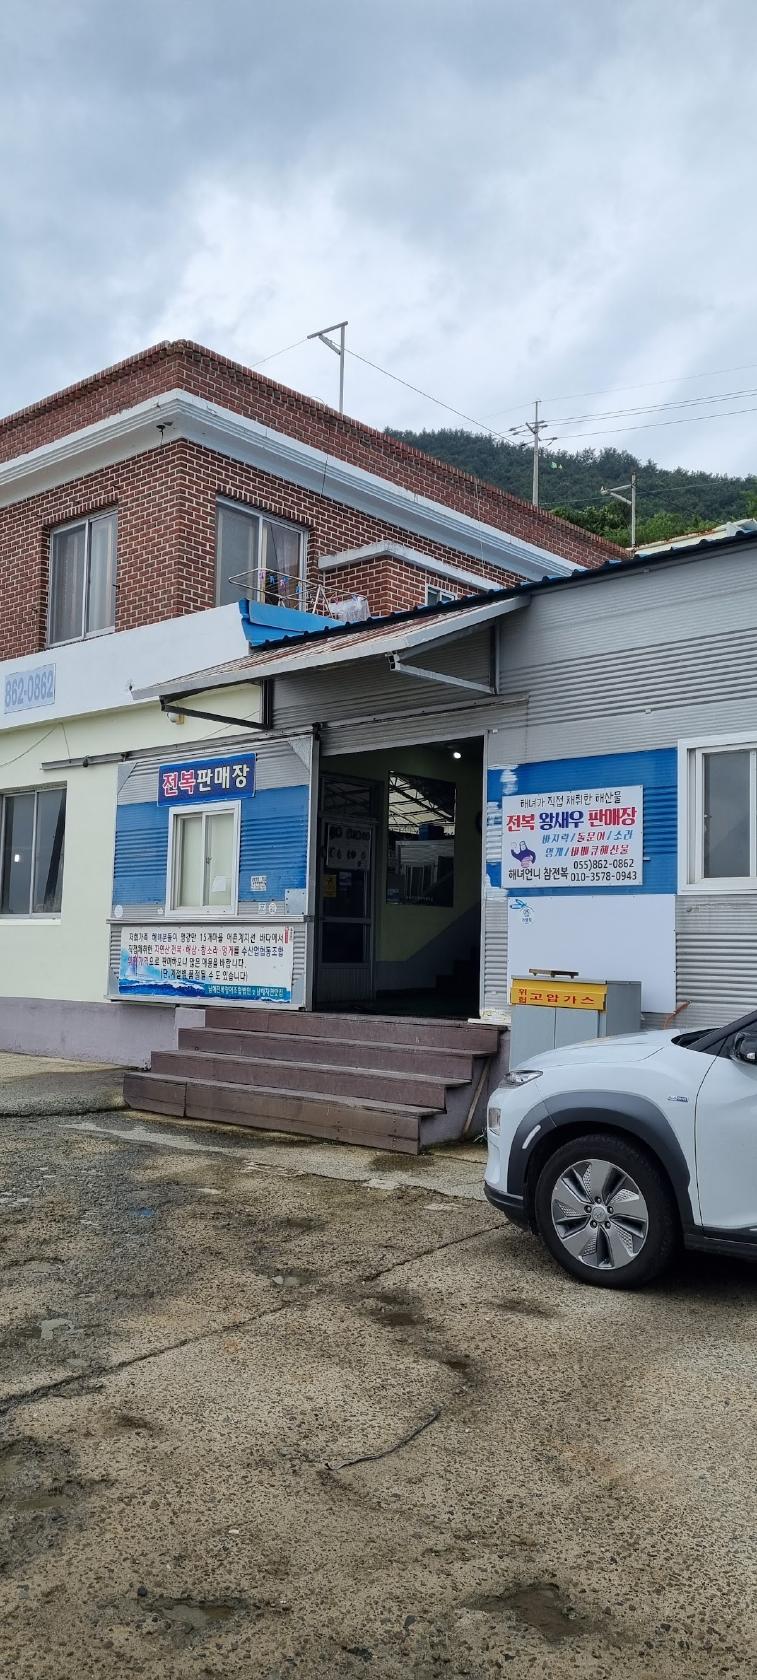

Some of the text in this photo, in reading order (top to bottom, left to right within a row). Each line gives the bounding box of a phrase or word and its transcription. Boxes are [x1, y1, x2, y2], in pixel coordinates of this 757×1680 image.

[5, 671, 54, 707] 862-0862
[162, 763, 250, 797] 전복판매장
[520, 791, 622, 808] 해녀가 직접 채취한 해산물
[506, 806, 637, 832] 전복 왕새우 판매장
[573, 858, 634, 872] 055)862-0862
[508, 867, 637, 882] 해녀언니 참전복 010-3578-0943
[259, 933, 284, 943] 바다에서
[518, 988, 527, 1005] 위험
[529, 992, 595, 1005] 고압가스
